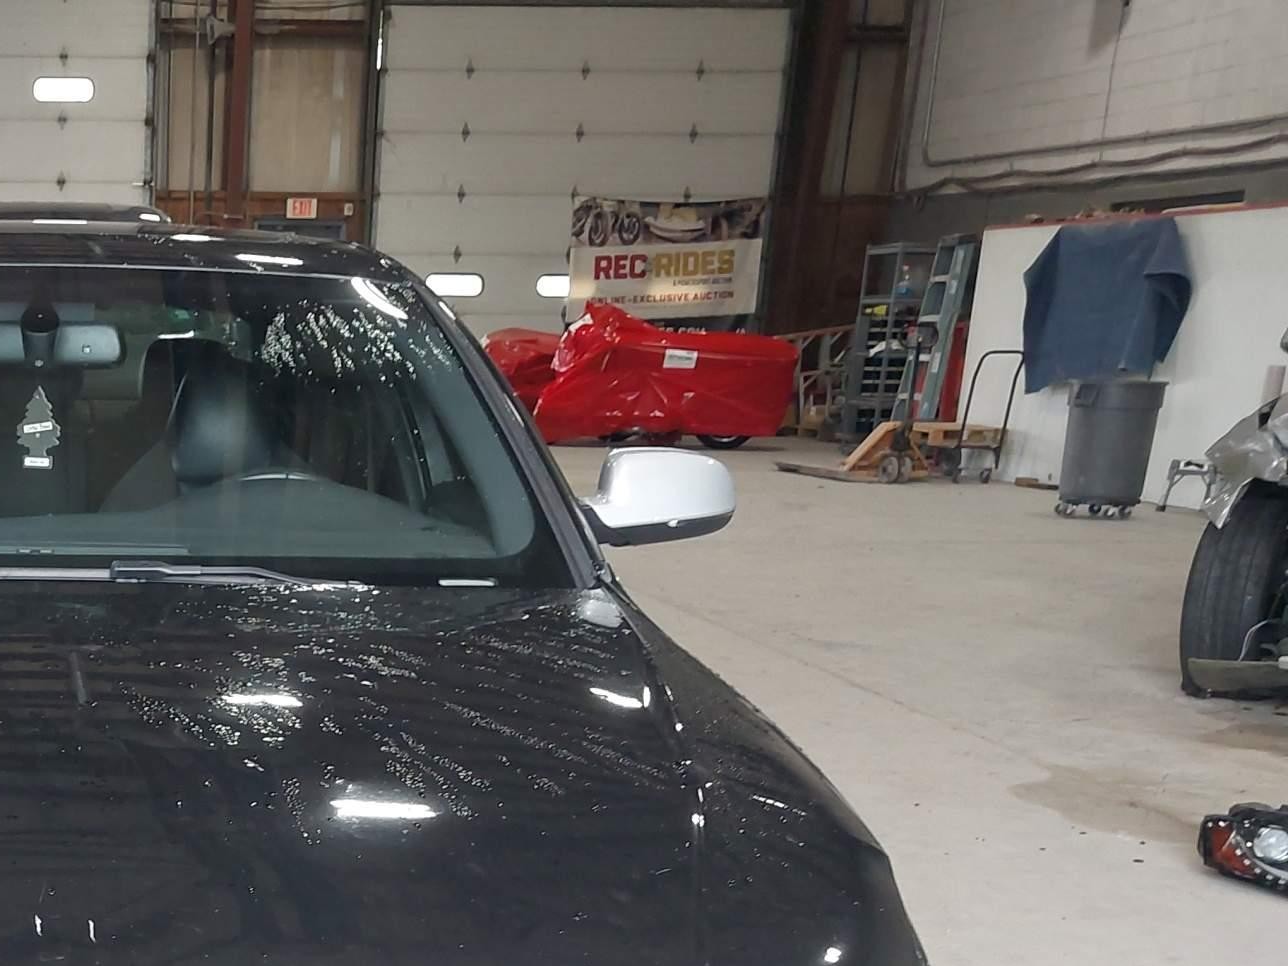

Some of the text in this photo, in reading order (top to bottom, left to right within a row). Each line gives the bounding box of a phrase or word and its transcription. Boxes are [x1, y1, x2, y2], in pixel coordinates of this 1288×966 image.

[292, 199, 313, 216] EXIT
[654, 249, 735, 277] RIDES
[692, 289, 734, 301] AUCTION
